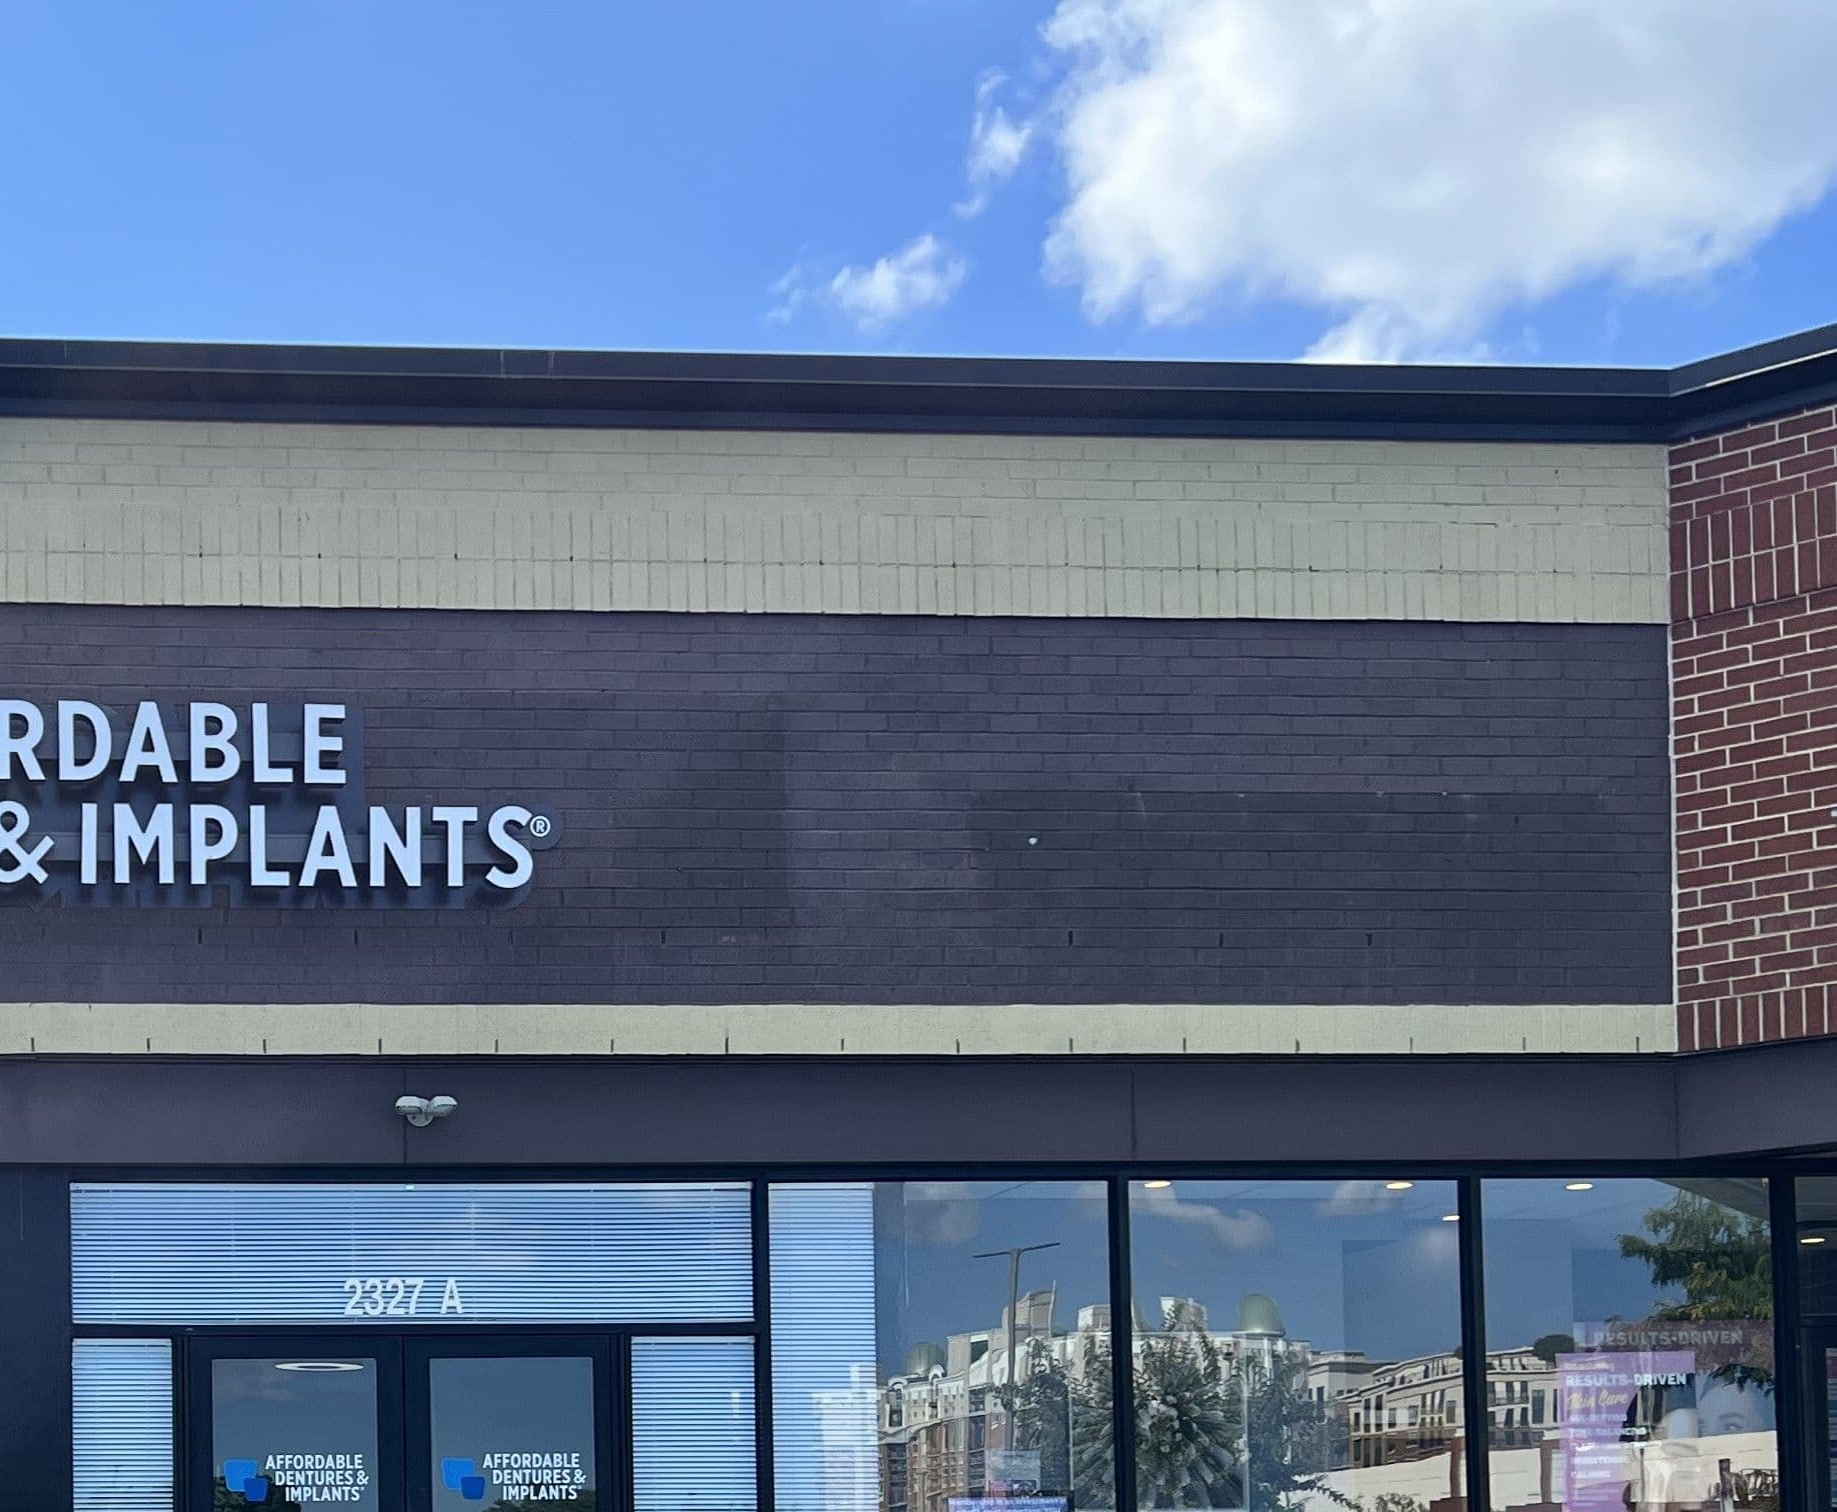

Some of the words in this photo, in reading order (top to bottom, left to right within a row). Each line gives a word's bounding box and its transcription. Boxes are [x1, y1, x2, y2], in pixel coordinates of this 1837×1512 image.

[343, 1277, 424, 1316] 2327
[440, 1277, 463, 1315] A
[265, 1454, 363, 1470] AFFORDABLE
[482, 1453, 580, 1469] AFFORDABLE
[275, 1470, 353, 1486] DENTURES
[356, 1471, 369, 1485] &
[492, 1469, 571, 1485] DENTURES
[573, 1469, 587, 1484] &
